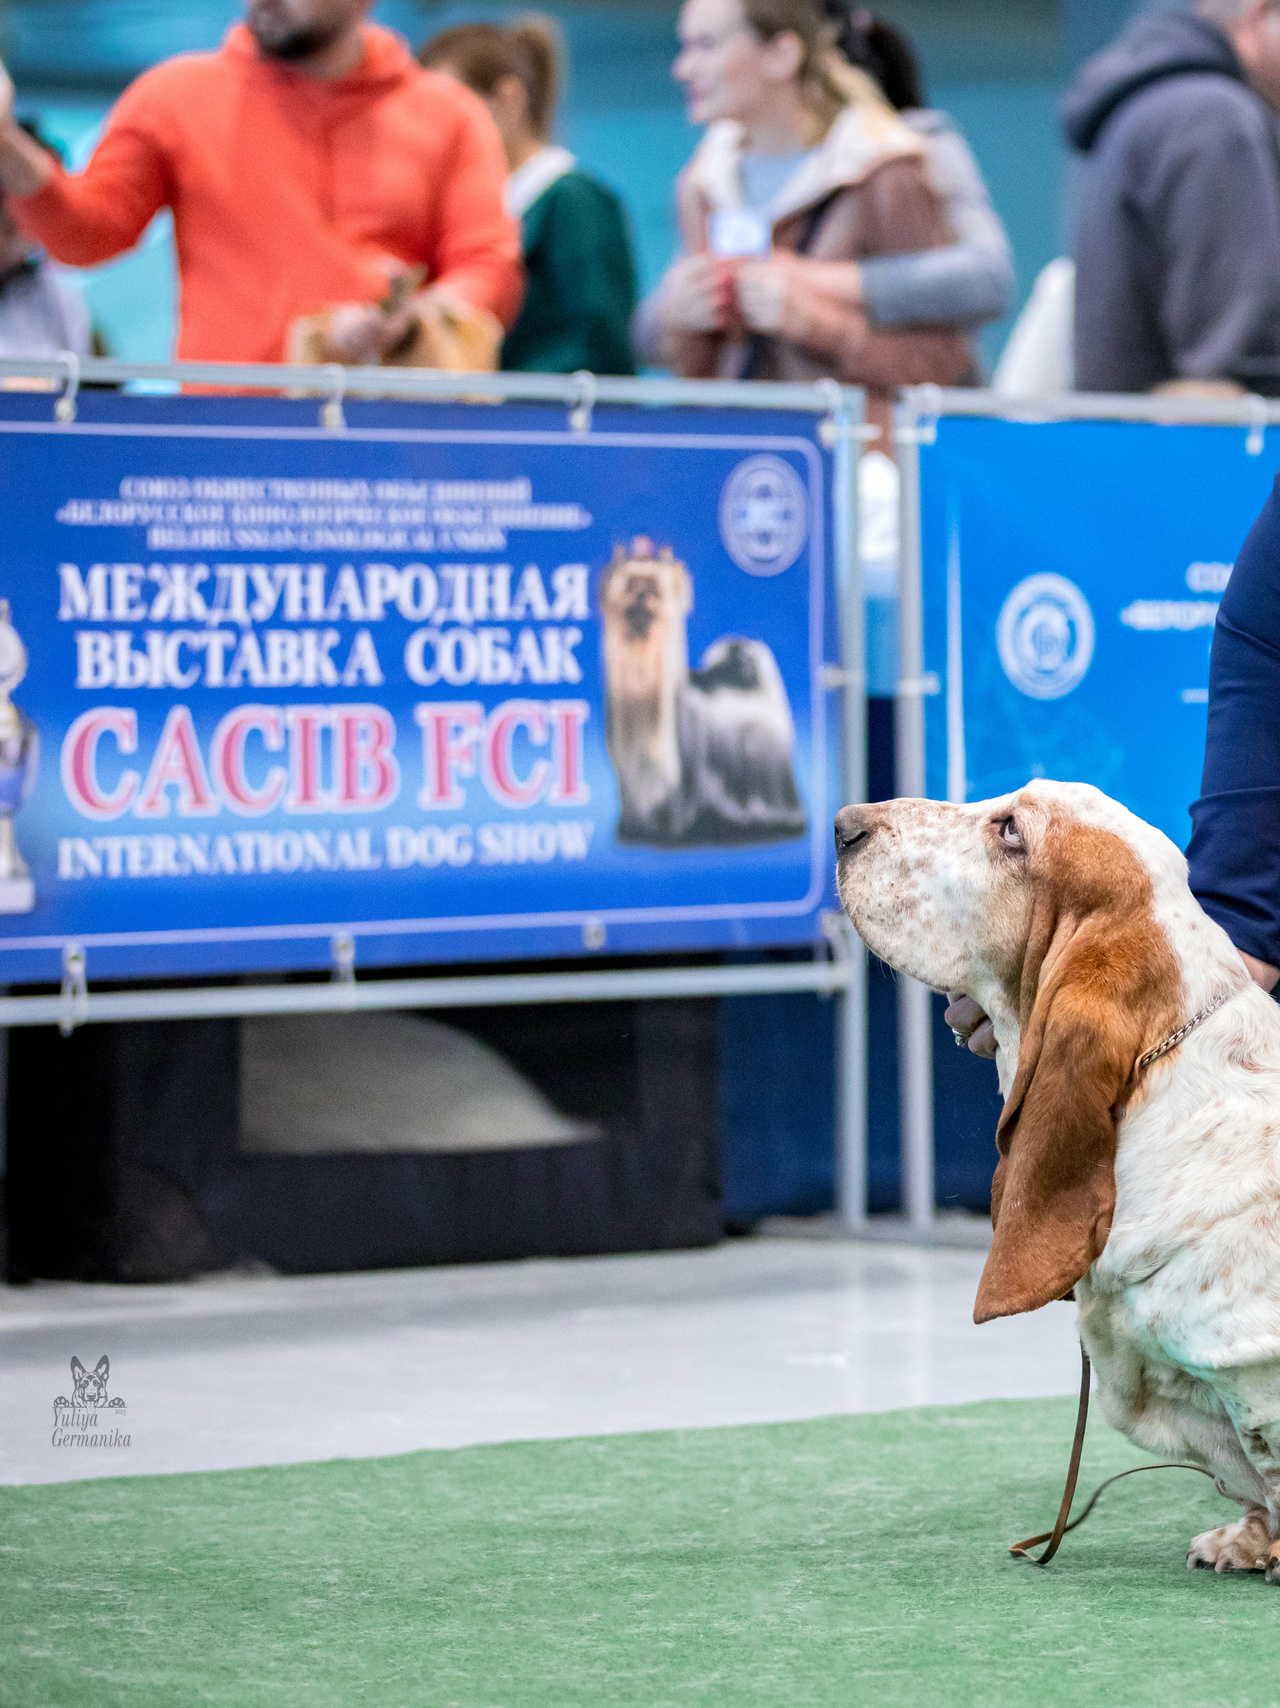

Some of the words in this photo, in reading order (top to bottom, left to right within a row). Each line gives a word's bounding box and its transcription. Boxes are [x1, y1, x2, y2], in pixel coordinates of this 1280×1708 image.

[58, 562, 590, 628] МЕЖДУНАРОДНАЯ
[75, 629, 384, 690] ВЫСТАВКА
[404, 626, 583, 687] СОБАК
[59, 703, 401, 821] CACIB
[414, 699, 591, 811] FCI
[58, 826, 382, 880] INTERNATIONAL
[385, 823, 474, 870] DOG
[477, 819, 595, 867] SHOW
